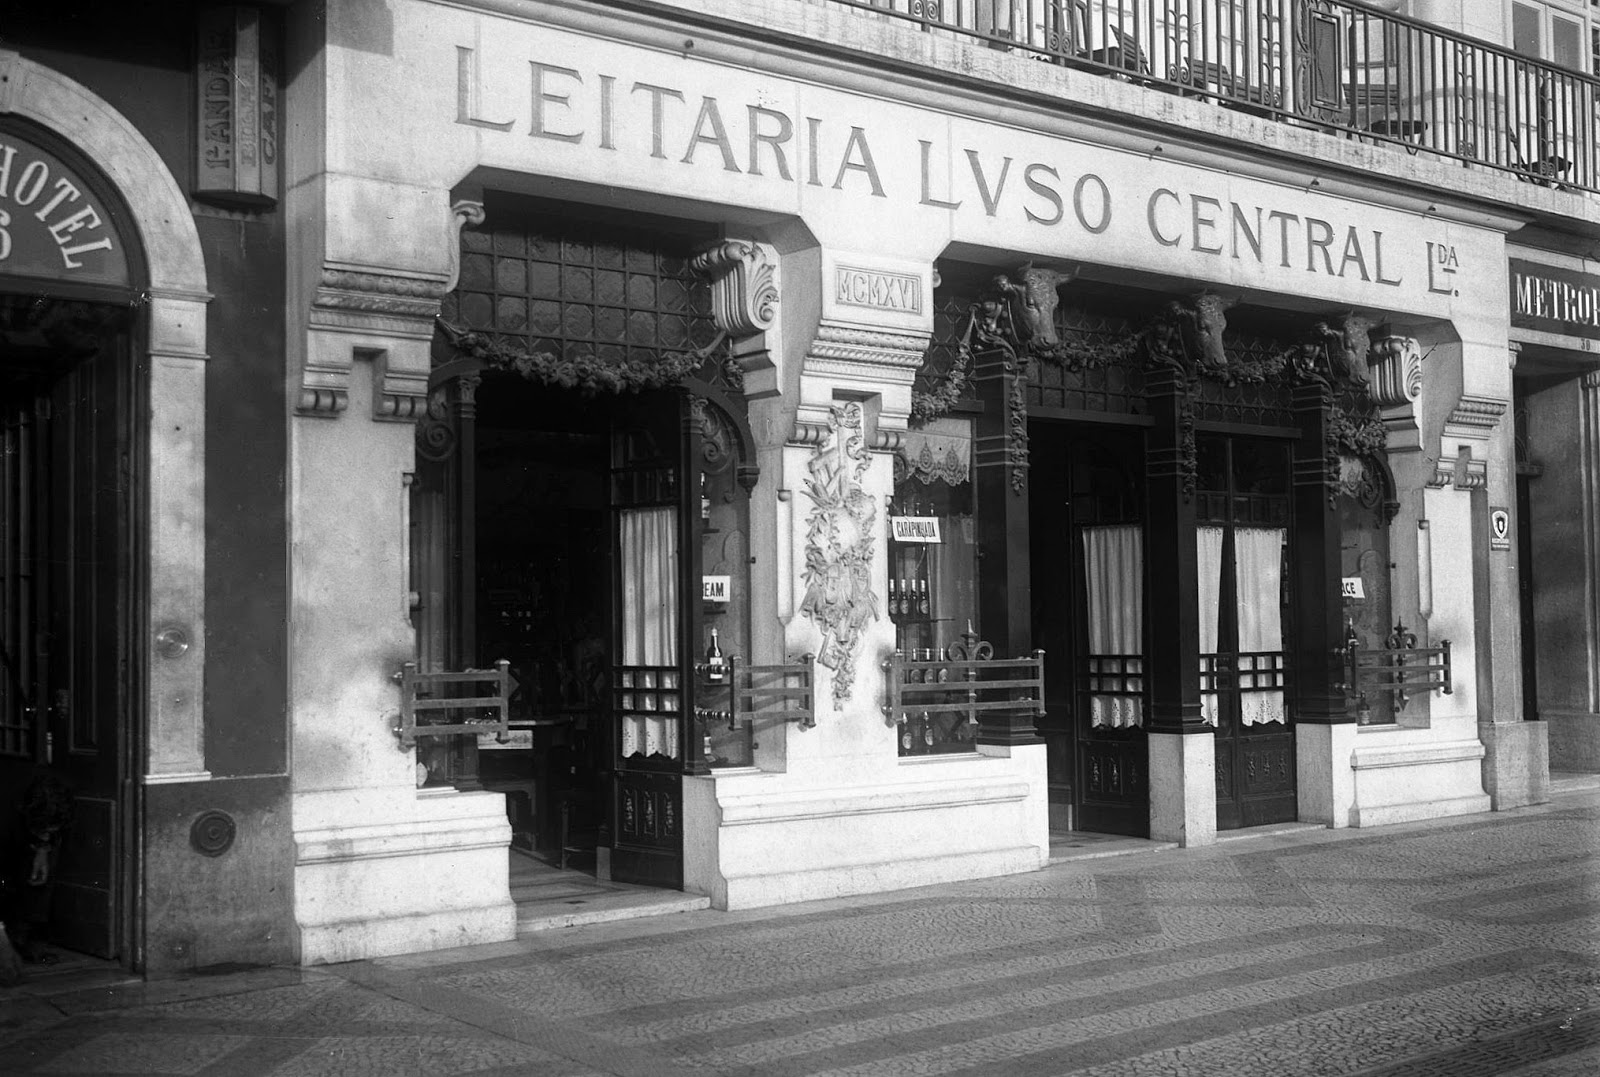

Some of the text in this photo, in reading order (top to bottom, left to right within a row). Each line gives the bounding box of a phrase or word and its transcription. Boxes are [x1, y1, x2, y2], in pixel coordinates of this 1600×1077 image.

[454, 45, 887, 198] LEITARIA
[918, 139, 1112, 235] LVSO
[1146, 187, 1403, 288] CENTRAL
[837, 270, 917, 310] MCMXVI
